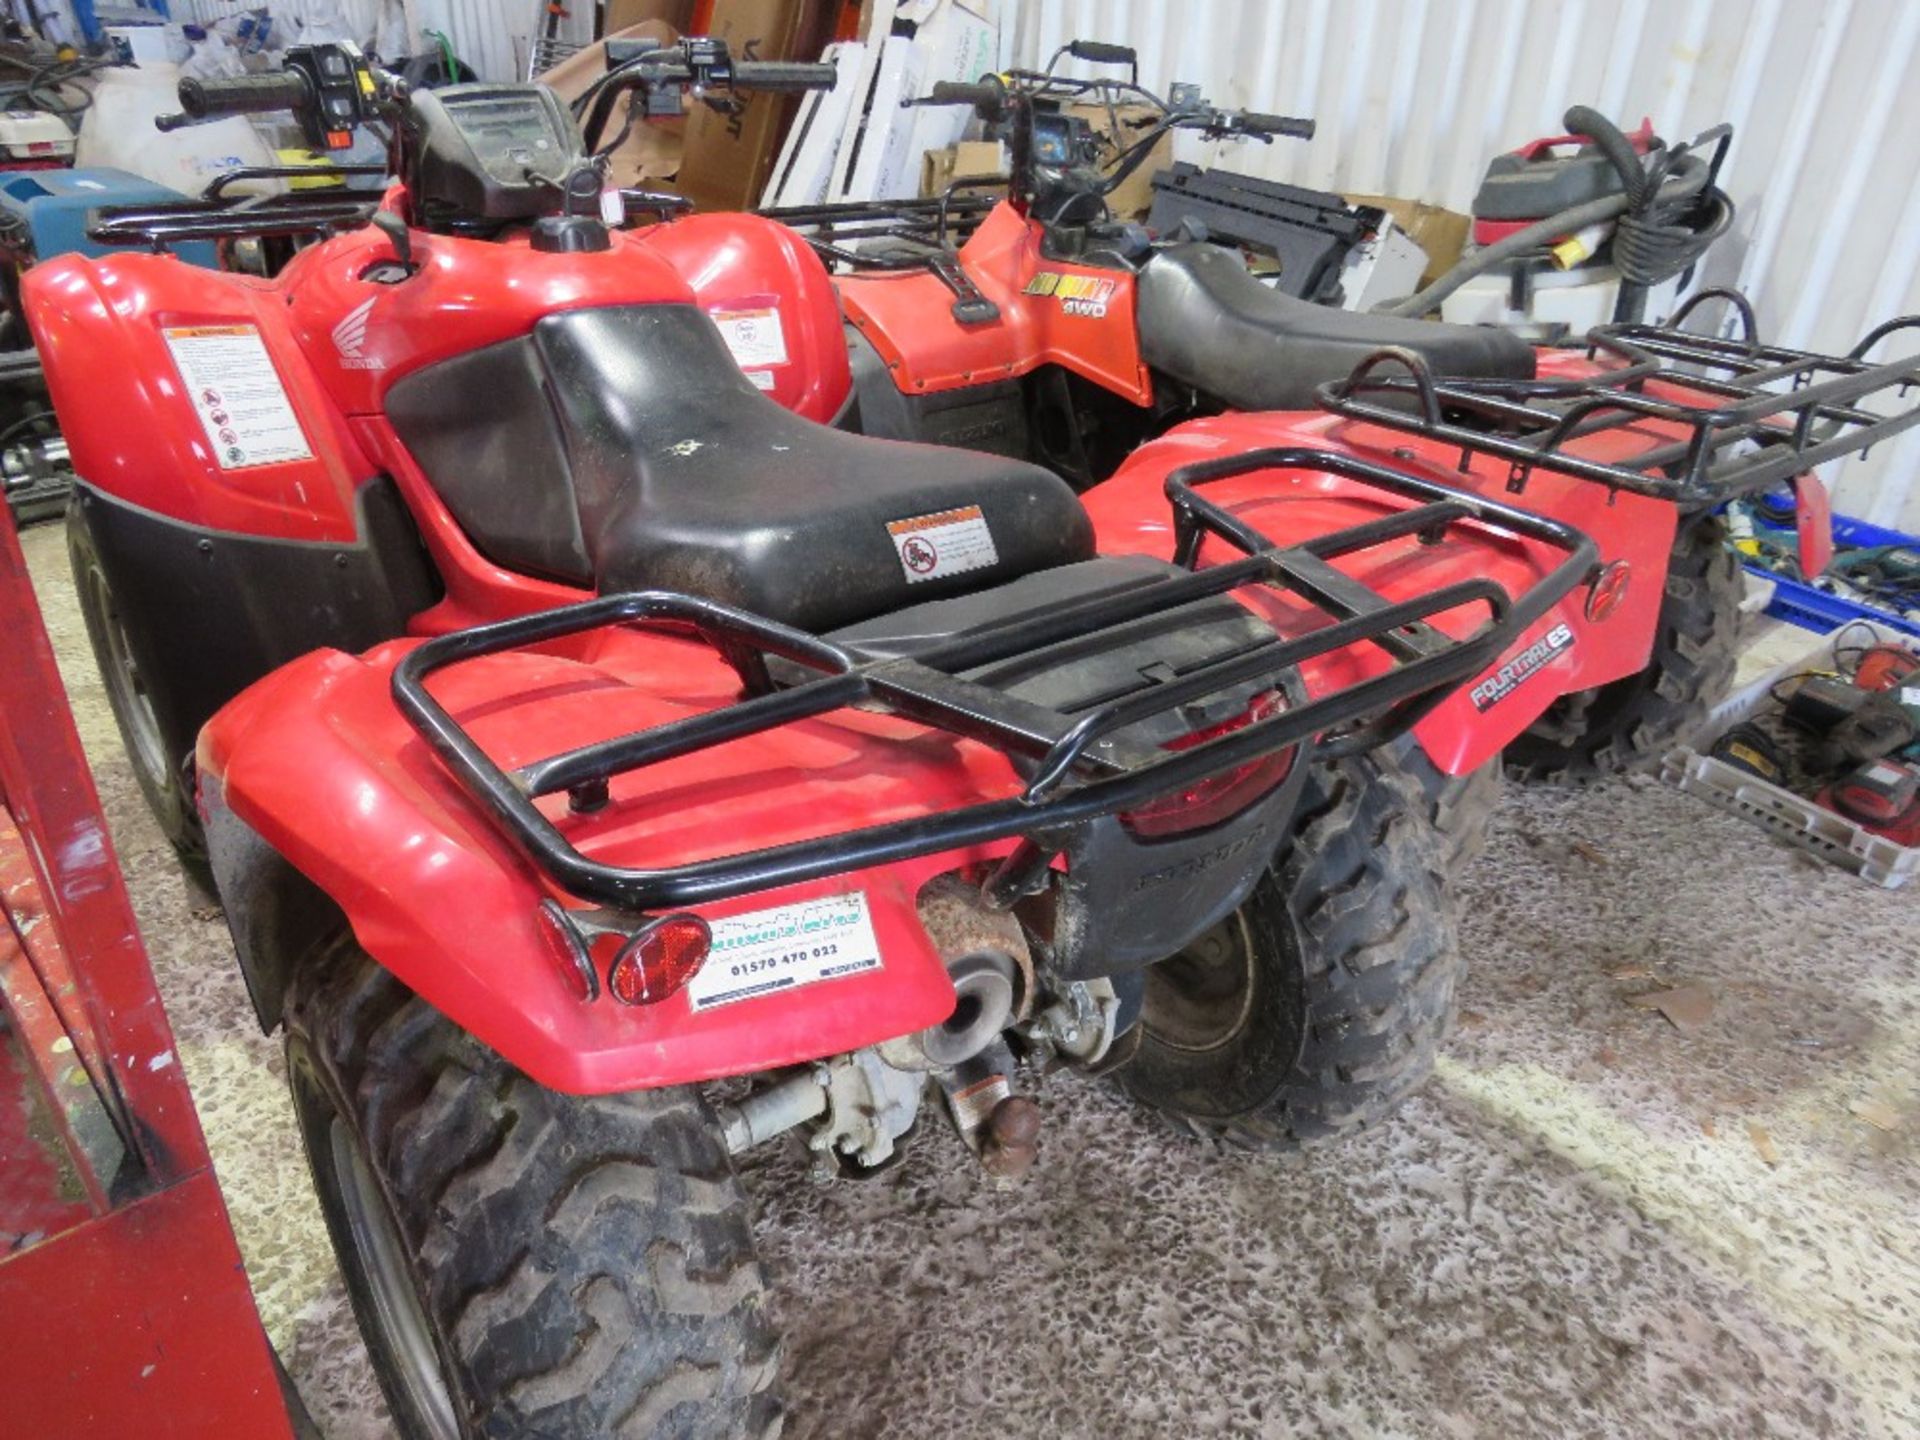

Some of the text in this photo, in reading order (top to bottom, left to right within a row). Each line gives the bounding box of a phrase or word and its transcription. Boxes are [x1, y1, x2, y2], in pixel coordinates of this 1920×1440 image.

[339, 358, 387, 369] HONDA
[1470, 637, 1553, 707] FOURTRAX
[1545, 623, 1573, 649] ES
[730, 956, 777, 977] 01570
[781, 950, 808, 966] 470
[812, 944, 838, 960] 022
